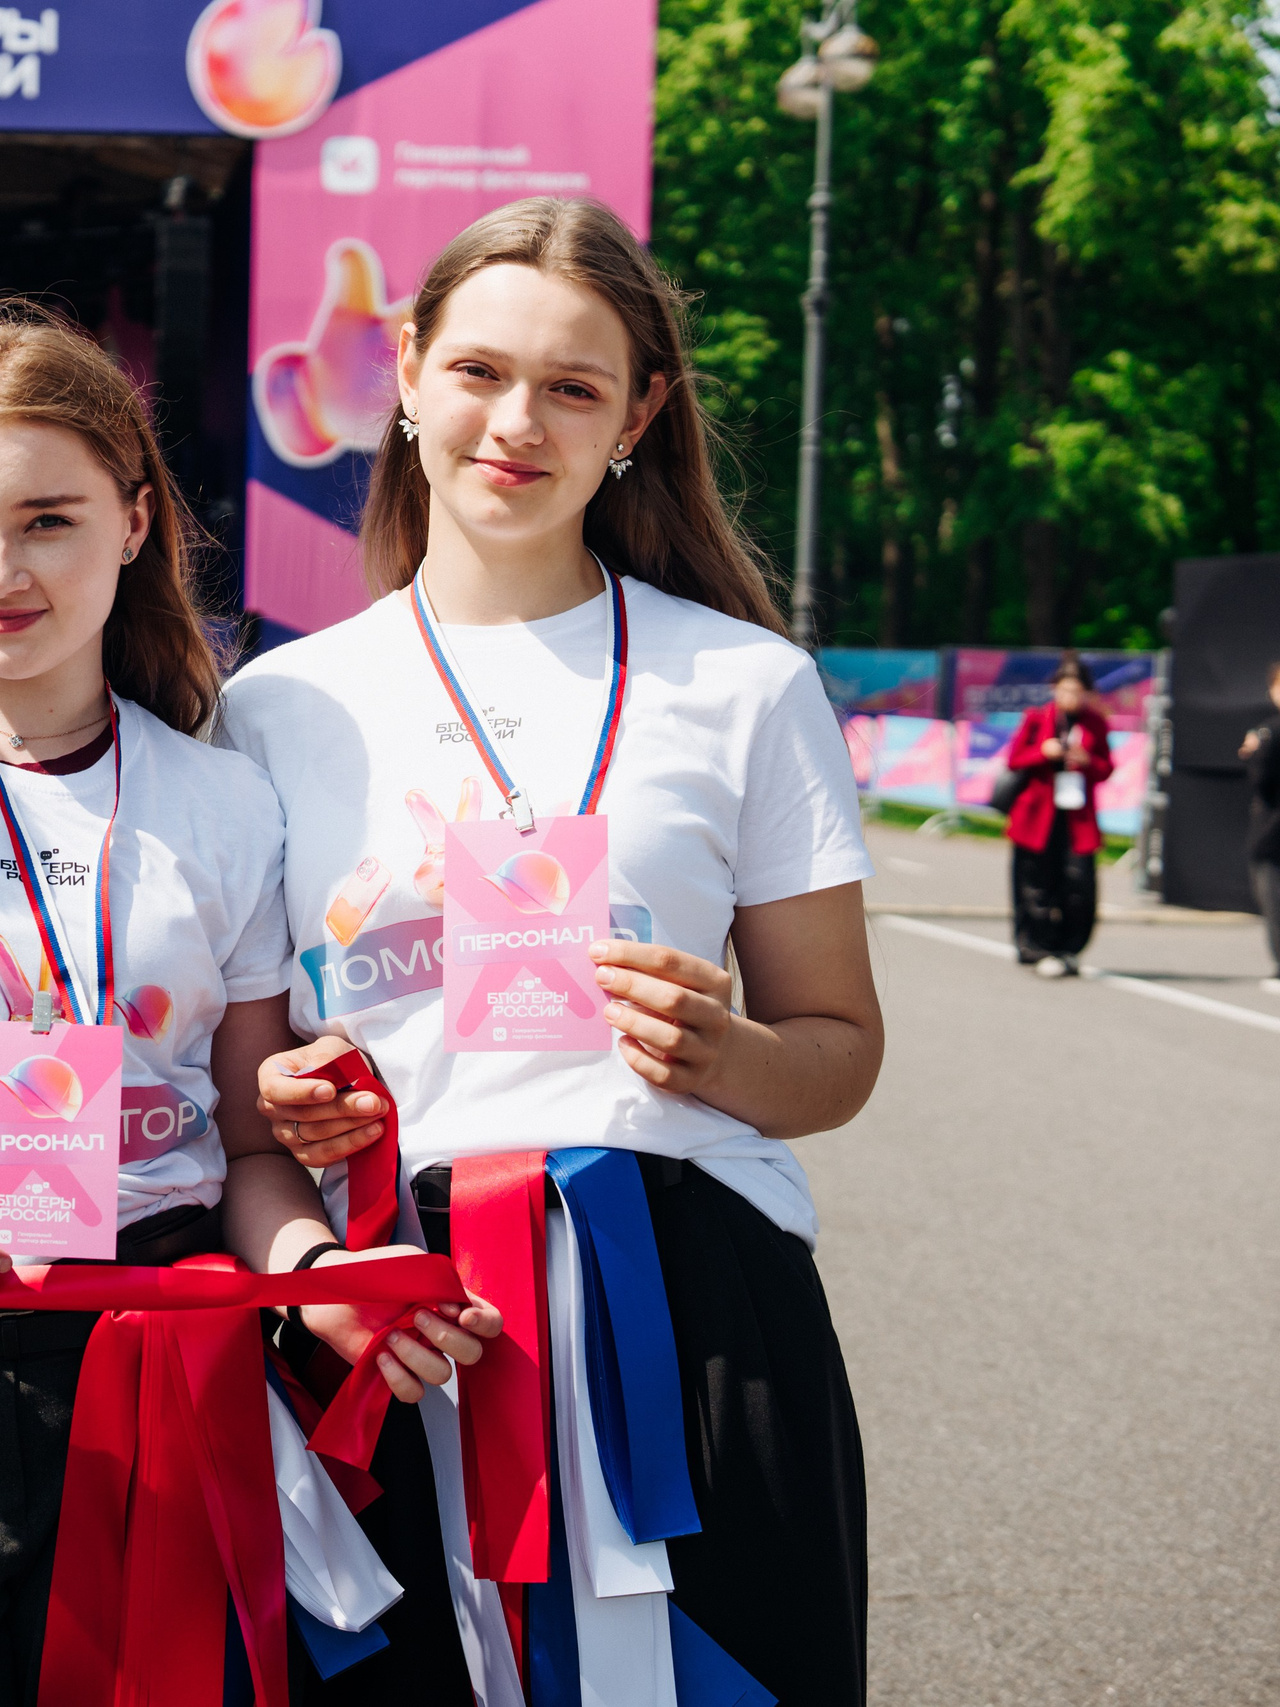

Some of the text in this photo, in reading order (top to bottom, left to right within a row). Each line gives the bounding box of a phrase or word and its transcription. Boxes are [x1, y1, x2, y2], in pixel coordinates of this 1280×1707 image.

[459, 925, 595, 953] ПЕРСОНАЛ
[487, 991, 568, 1005] БЛОГЕРЫ
[492, 1005, 564, 1018] РОССИИ
[0, 1208, 70, 1223] РОССИИ
